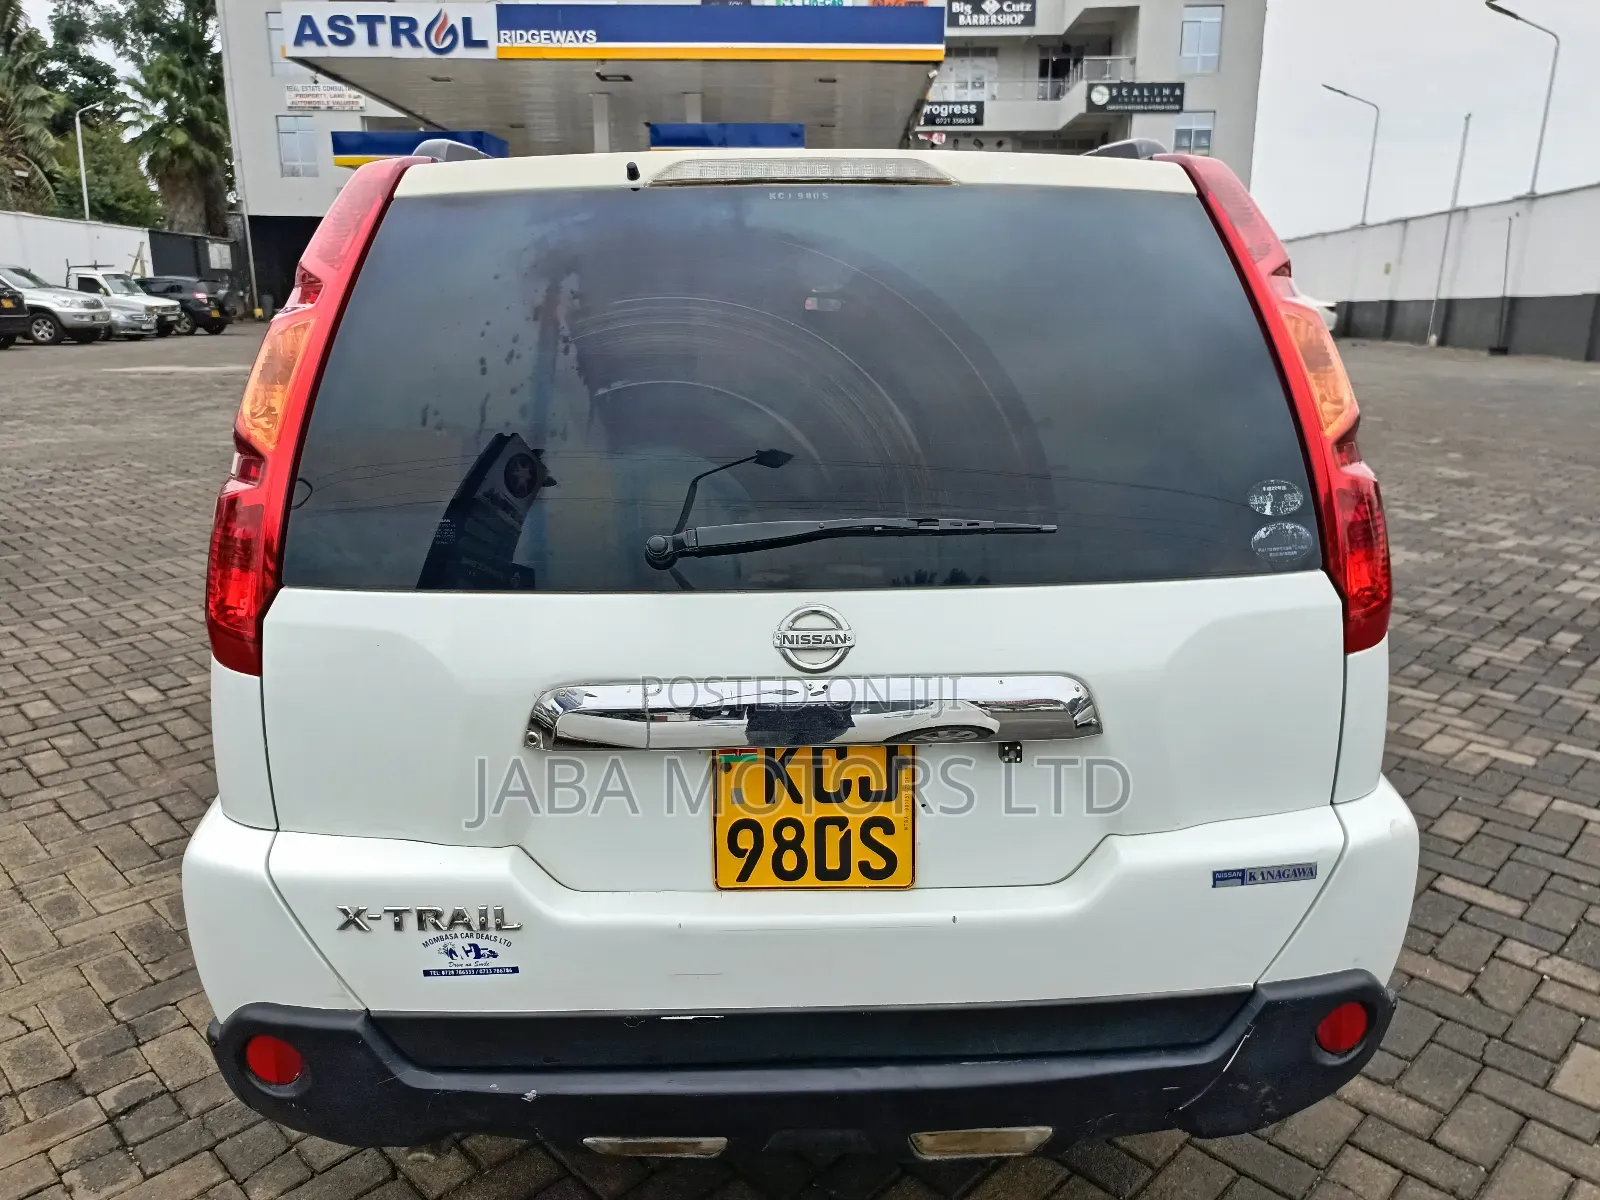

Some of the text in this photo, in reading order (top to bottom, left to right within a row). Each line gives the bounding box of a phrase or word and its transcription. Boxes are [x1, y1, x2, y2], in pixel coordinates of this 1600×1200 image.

[951, 1, 1032, 15] Big Cutz
[959, 14, 1025, 25] BARBERSHOP
[293, 8, 489, 55] ASTROL
[499, 30, 597, 44] RIDGEWAYS
[1111, 87, 1181, 96] SCALINA
[782, 634, 846, 644] NISSAN
[764, 745, 899, 804] KCJ
[1248, 867, 1314, 881] KANAGAWA
[336, 905, 523, 931] X-TRAIL
[422, 933, 458, 948] MOMBASA
[476, 932, 498, 942] DEALS
[499, 937, 512, 947] LTD
